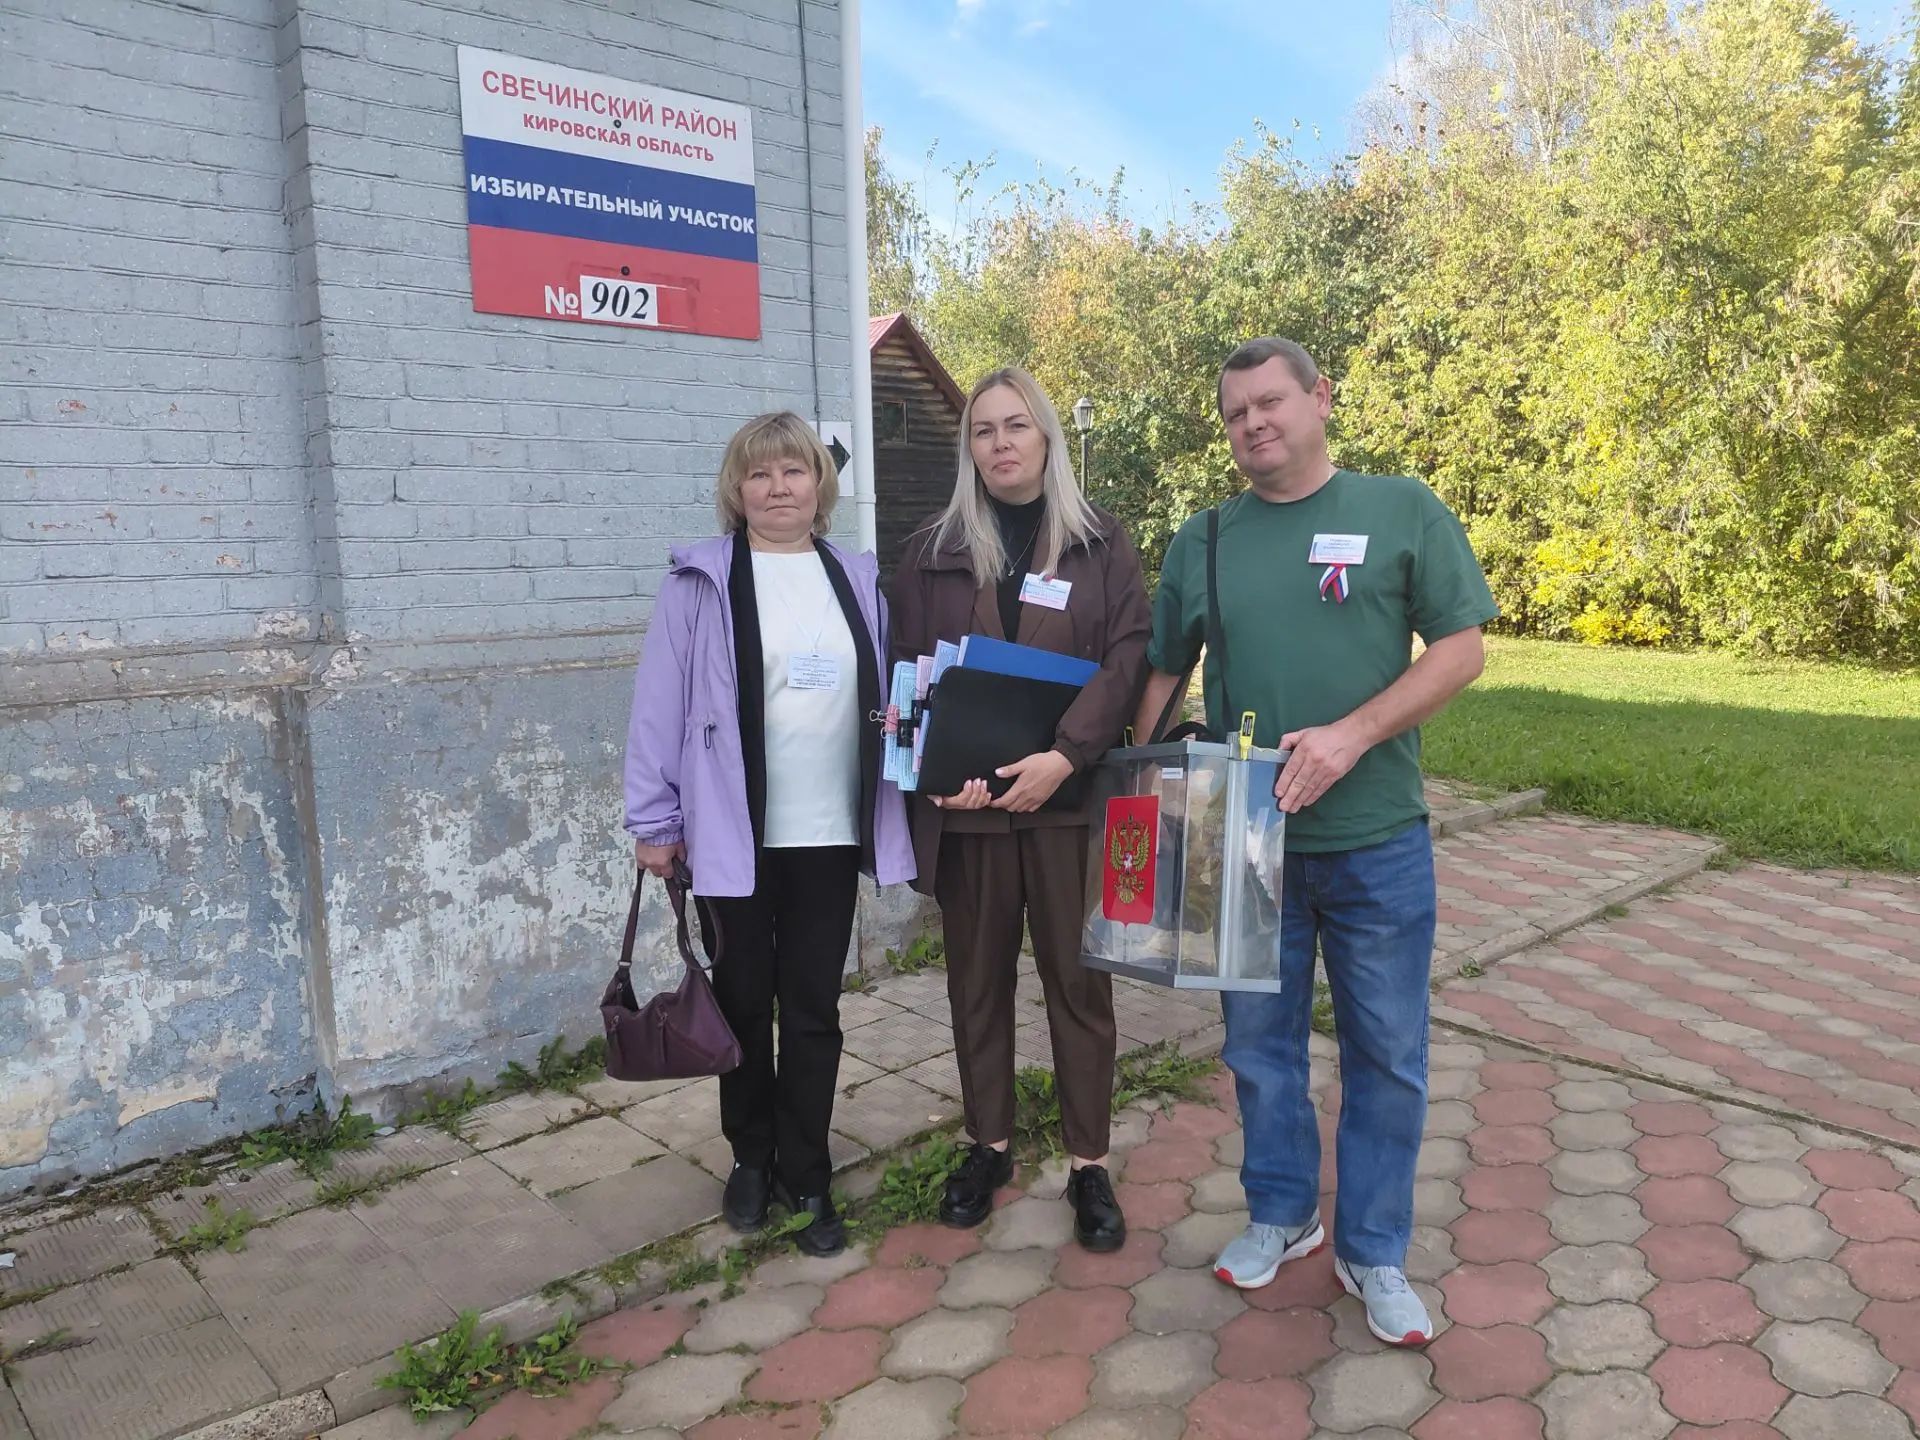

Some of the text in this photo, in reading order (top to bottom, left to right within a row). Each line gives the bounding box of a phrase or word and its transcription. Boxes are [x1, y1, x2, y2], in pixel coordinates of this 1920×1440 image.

[482, 70, 737, 141] СВЕЧИНСКИЙ РАЙОН
[523, 113, 714, 162] КИРОВСКАЯ ОБЛАСТЬ
[470, 173, 755, 234] ИЗБИРАТЕЛЬНЫЙ УЧАСТОК
[590, 281, 649, 319] 902
